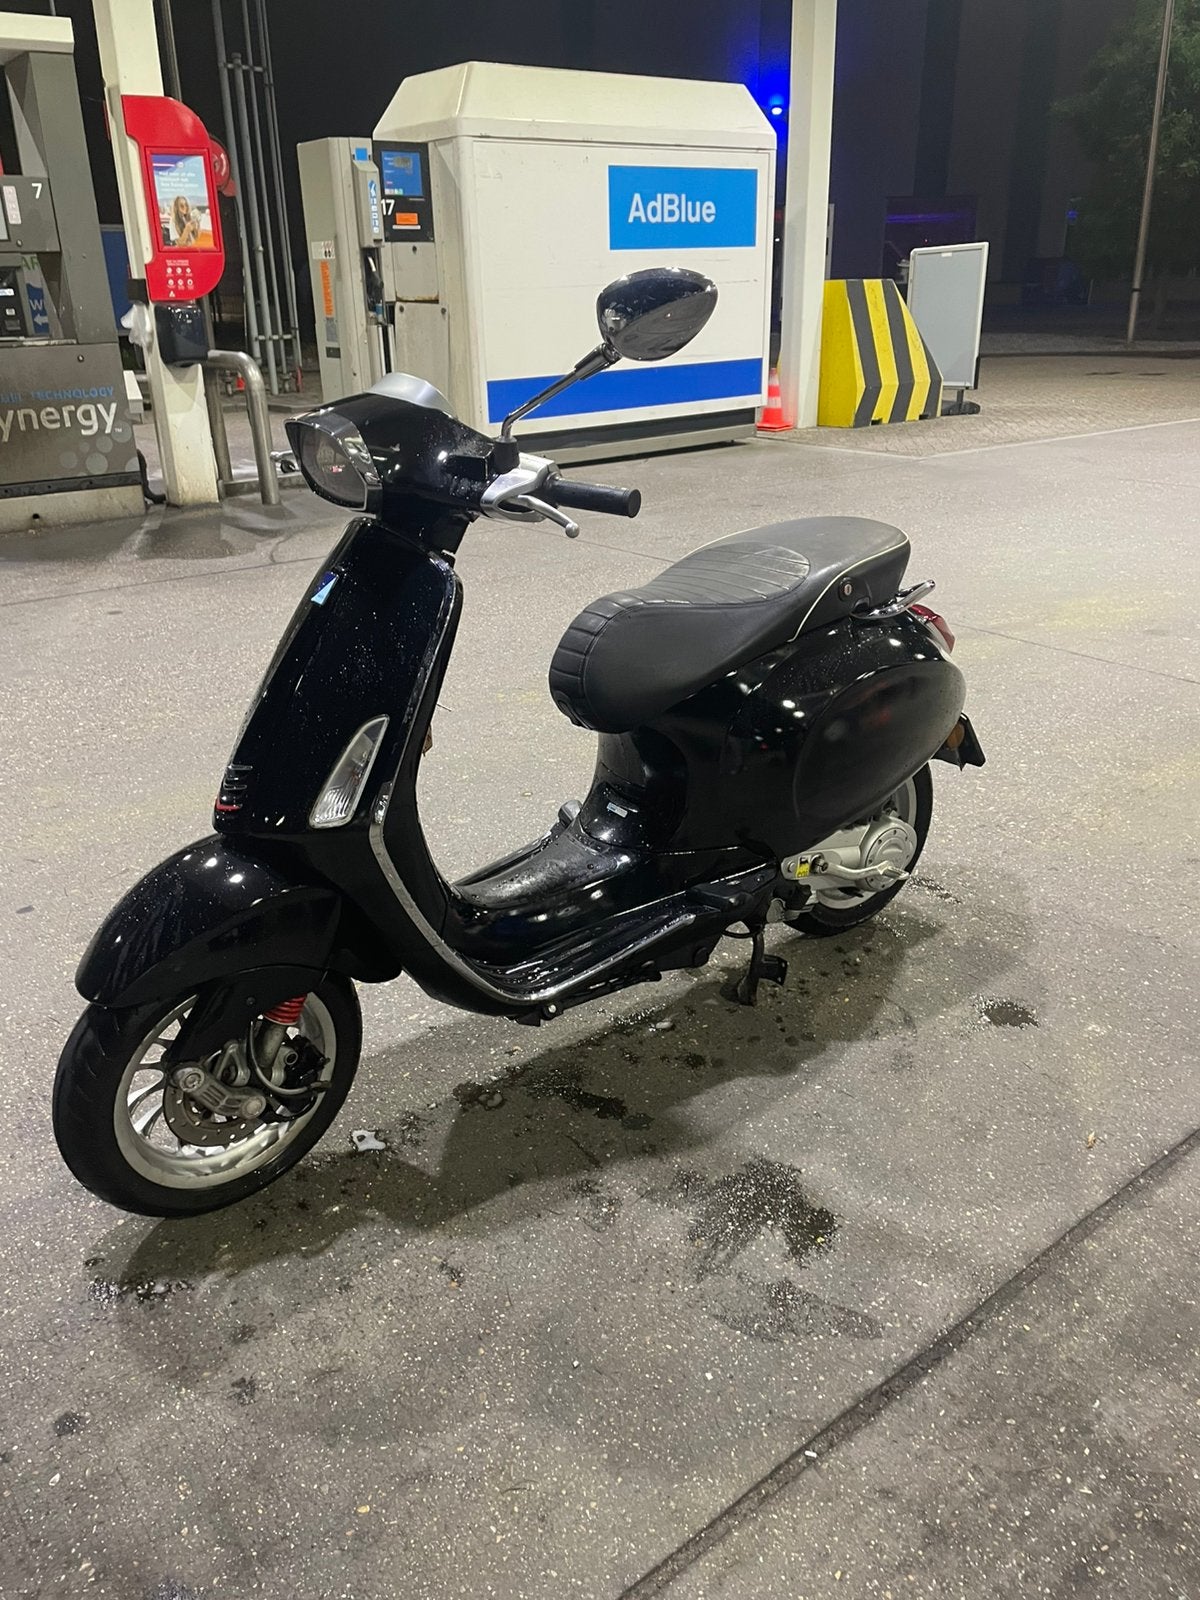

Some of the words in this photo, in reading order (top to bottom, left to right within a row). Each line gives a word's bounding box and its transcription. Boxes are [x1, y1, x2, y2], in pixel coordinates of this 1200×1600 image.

[31, 182, 42, 199] 7
[380, 198, 395, 216] 17
[628, 193, 716, 223] AdBlue
